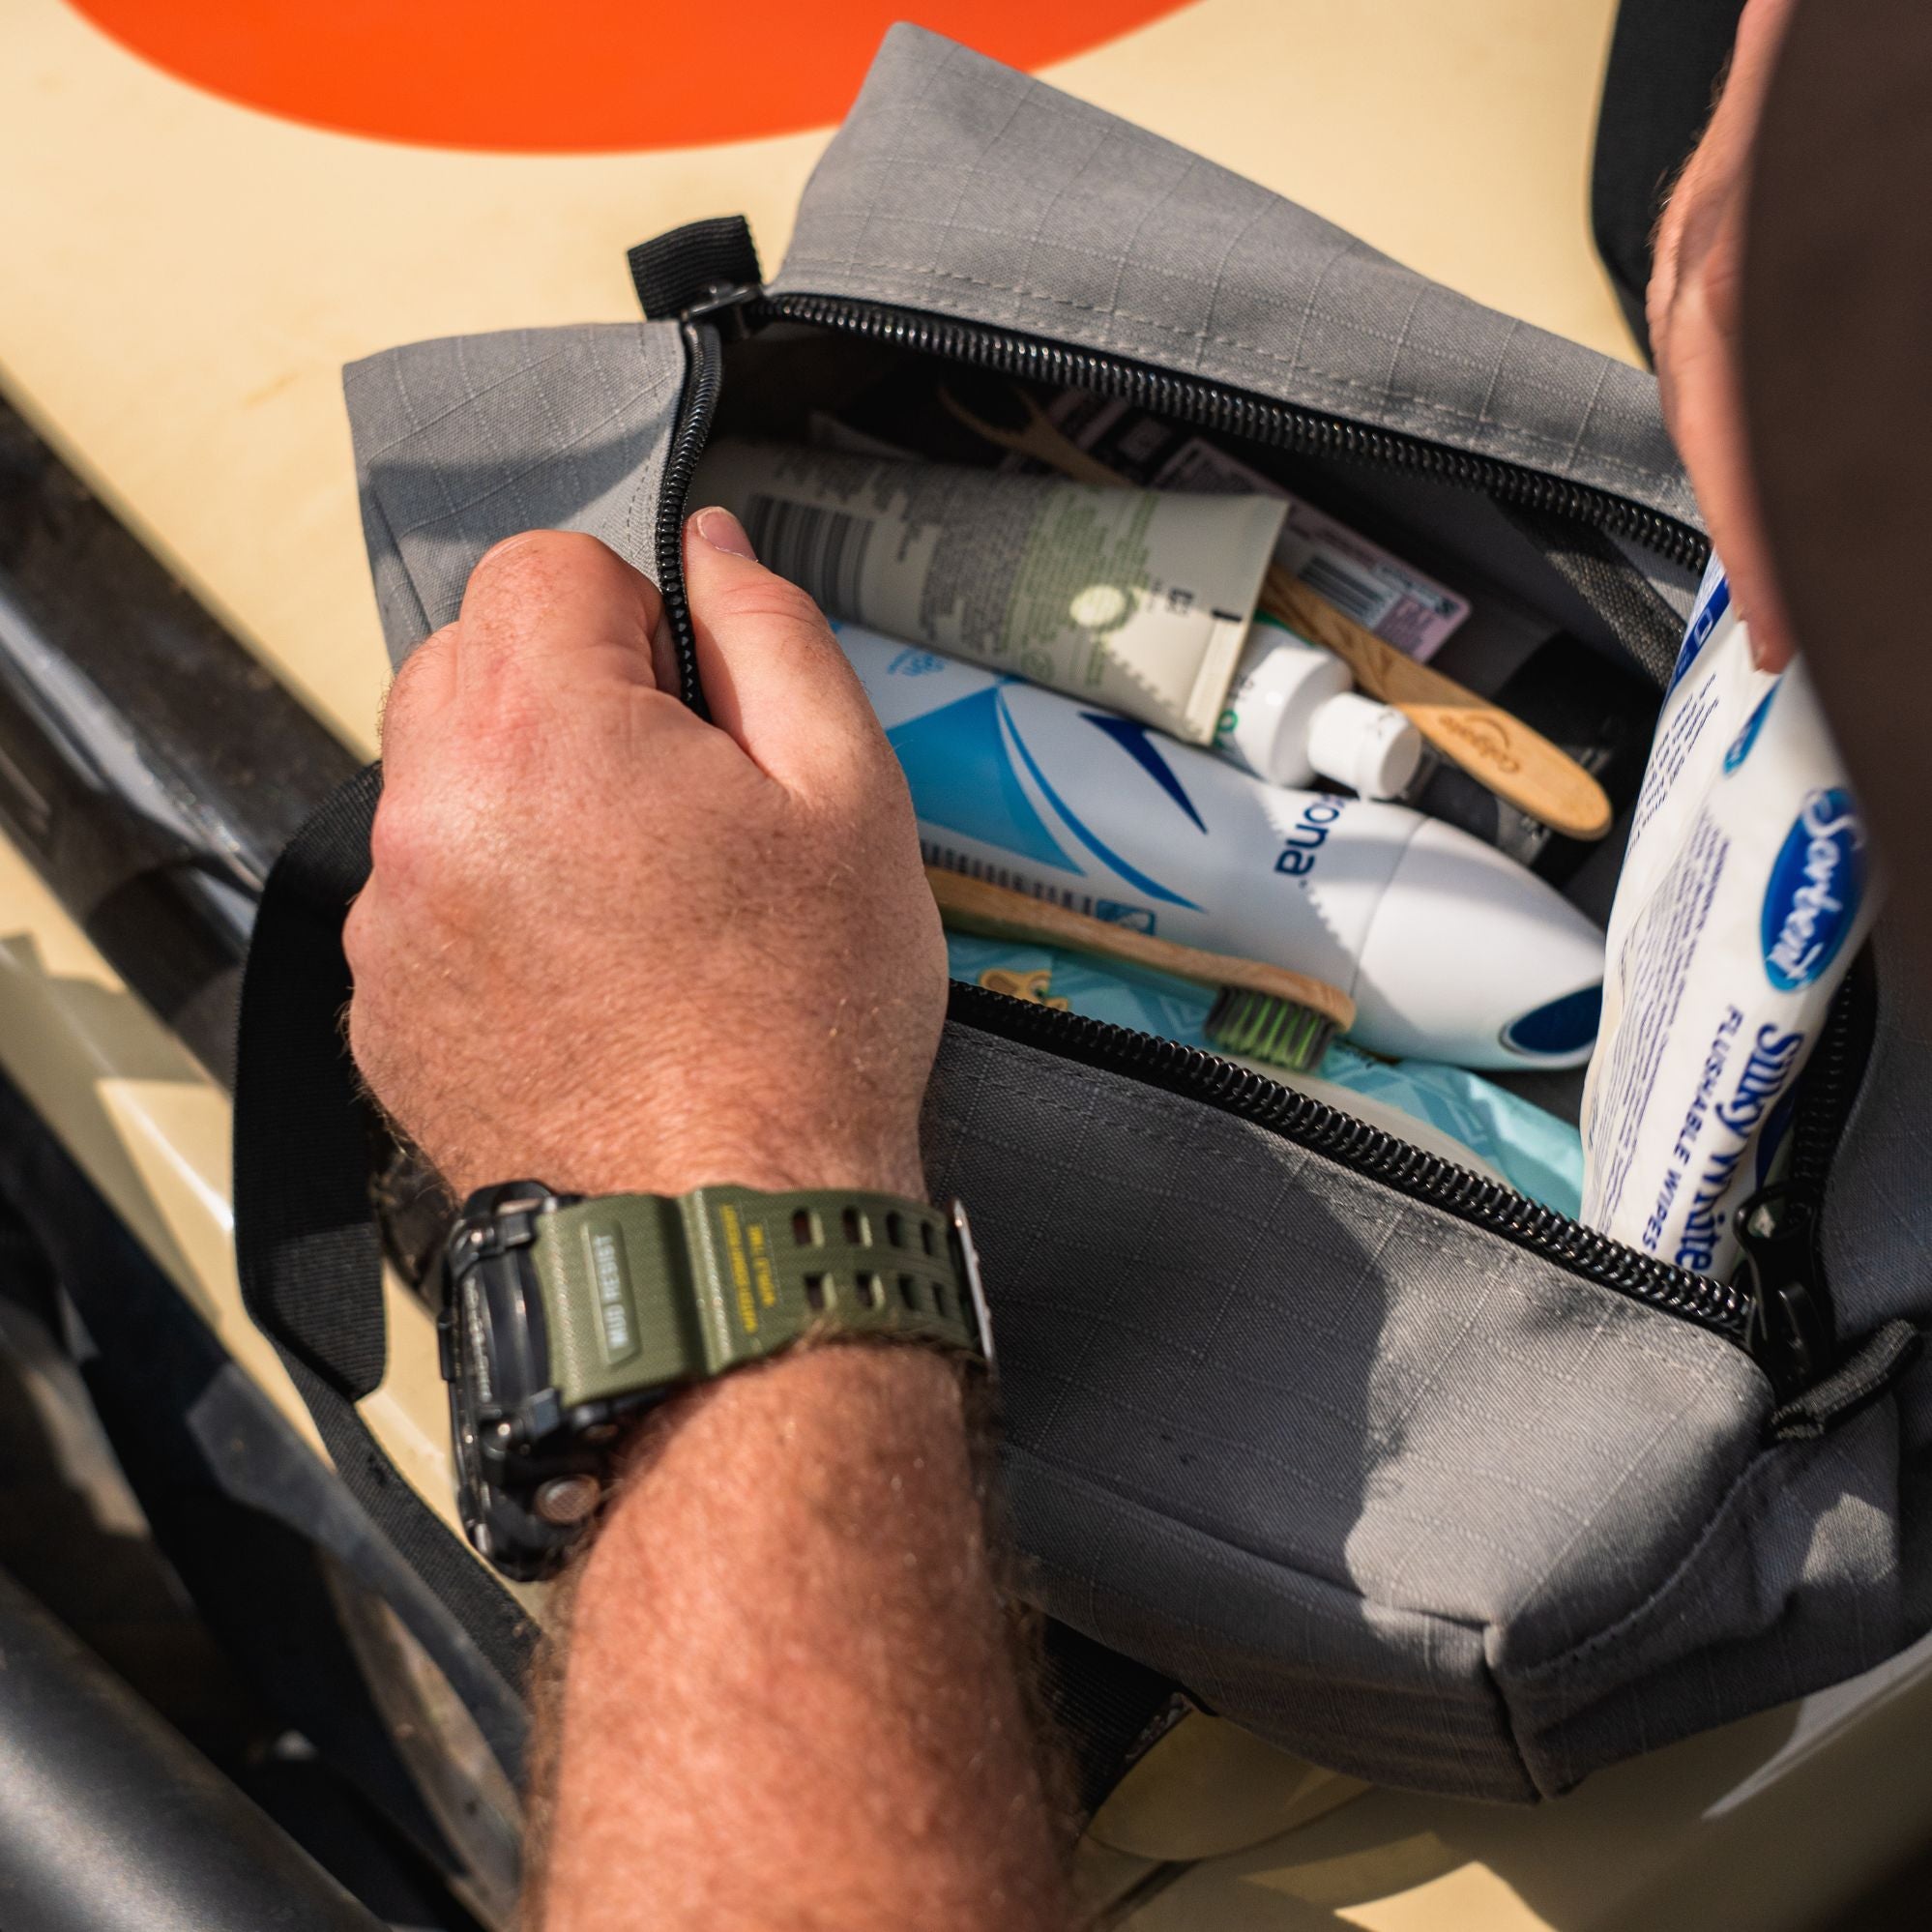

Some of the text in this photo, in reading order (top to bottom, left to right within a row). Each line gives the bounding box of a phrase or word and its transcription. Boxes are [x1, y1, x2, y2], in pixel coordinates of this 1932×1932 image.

[1764, 788, 1867, 980] Sorbent
[1673, 1005, 1744, 1166] FLUSHABLE
[1714, 1023, 1804, 1139] Silky
[1642, 1169, 1682, 1252] WIPES
[593, 1234, 628, 1349] MUD RESIST
